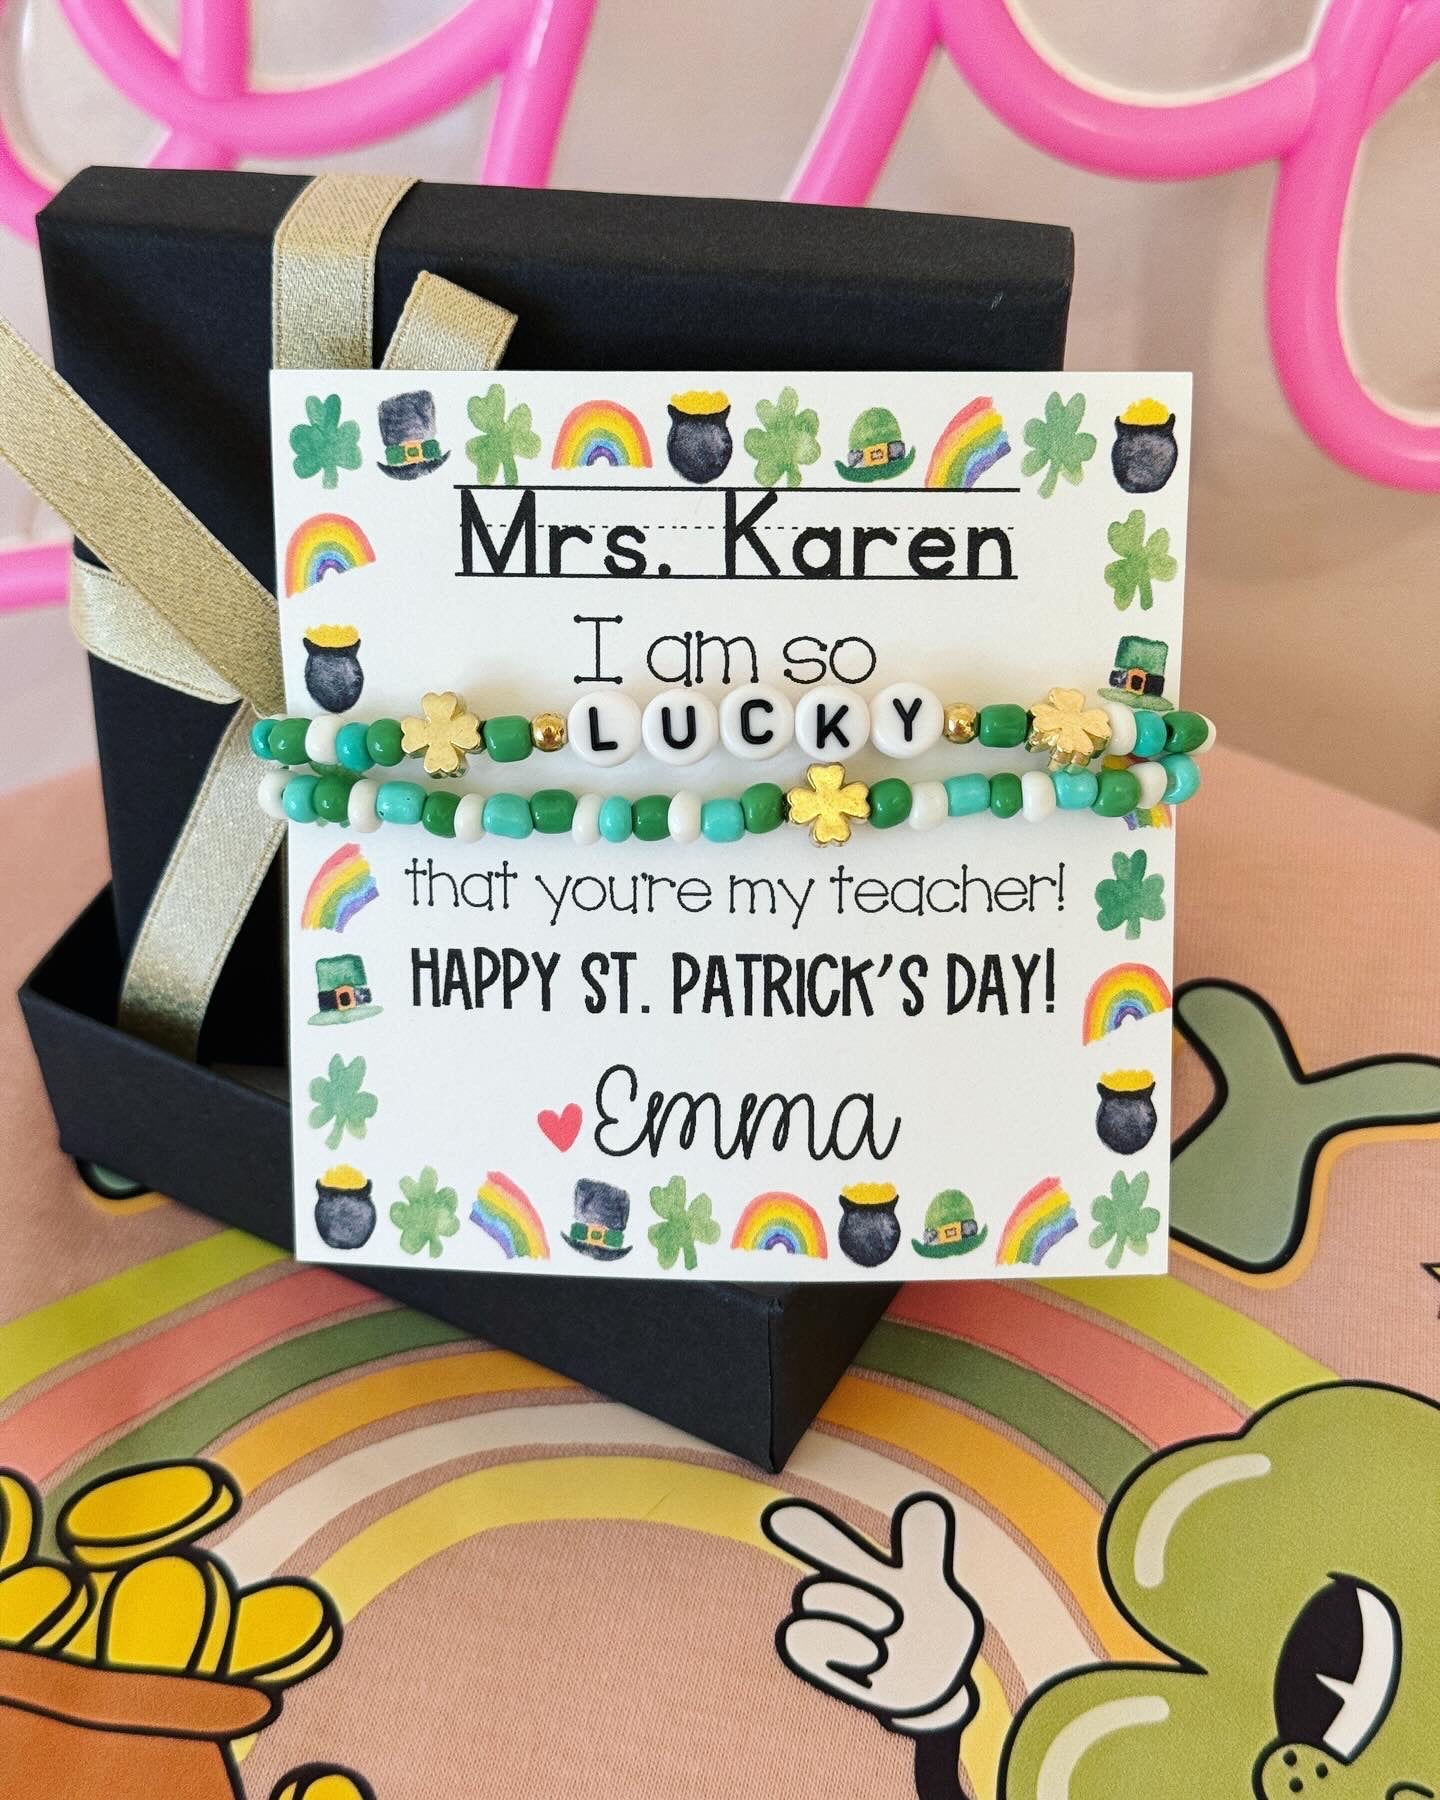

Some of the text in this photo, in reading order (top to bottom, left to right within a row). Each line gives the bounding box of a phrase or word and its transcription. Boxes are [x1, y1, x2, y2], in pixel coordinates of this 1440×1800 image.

[459, 490, 1014, 579] Mrs. Karen
[573, 614, 877, 688] I am so
[588, 697, 923, 752] LUCKY
[404, 857, 1066, 930] that you're my teacher!
[411, 946, 1055, 1018] HAPPY ST. PATRICK'S DAY!
[594, 1064, 902, 1161] Emma
